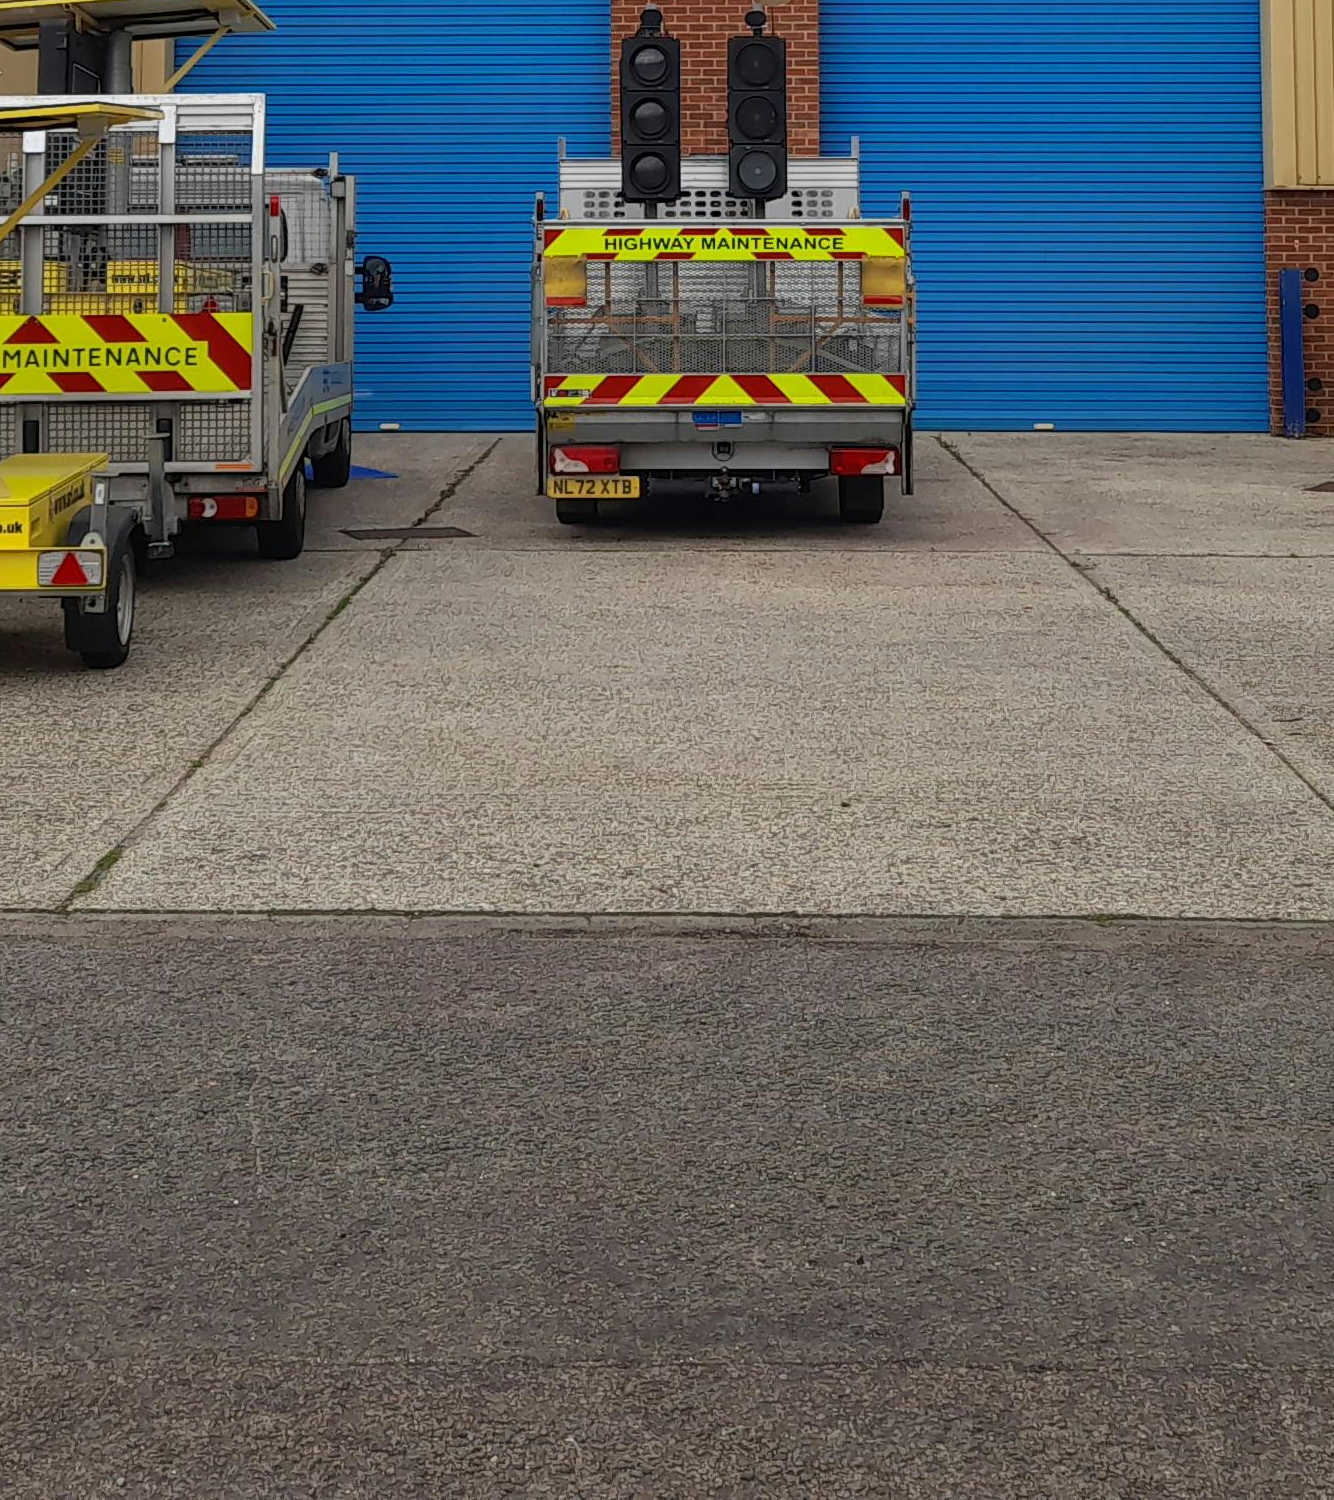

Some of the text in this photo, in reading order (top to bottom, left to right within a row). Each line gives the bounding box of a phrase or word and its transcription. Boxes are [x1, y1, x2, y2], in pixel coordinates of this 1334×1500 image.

[604, 237, 844, 250] HIGHWAY MAINTENANCE
[2, 347, 198, 369] MAINTENANCE
[553, 479, 632, 495] NL72 XTB
